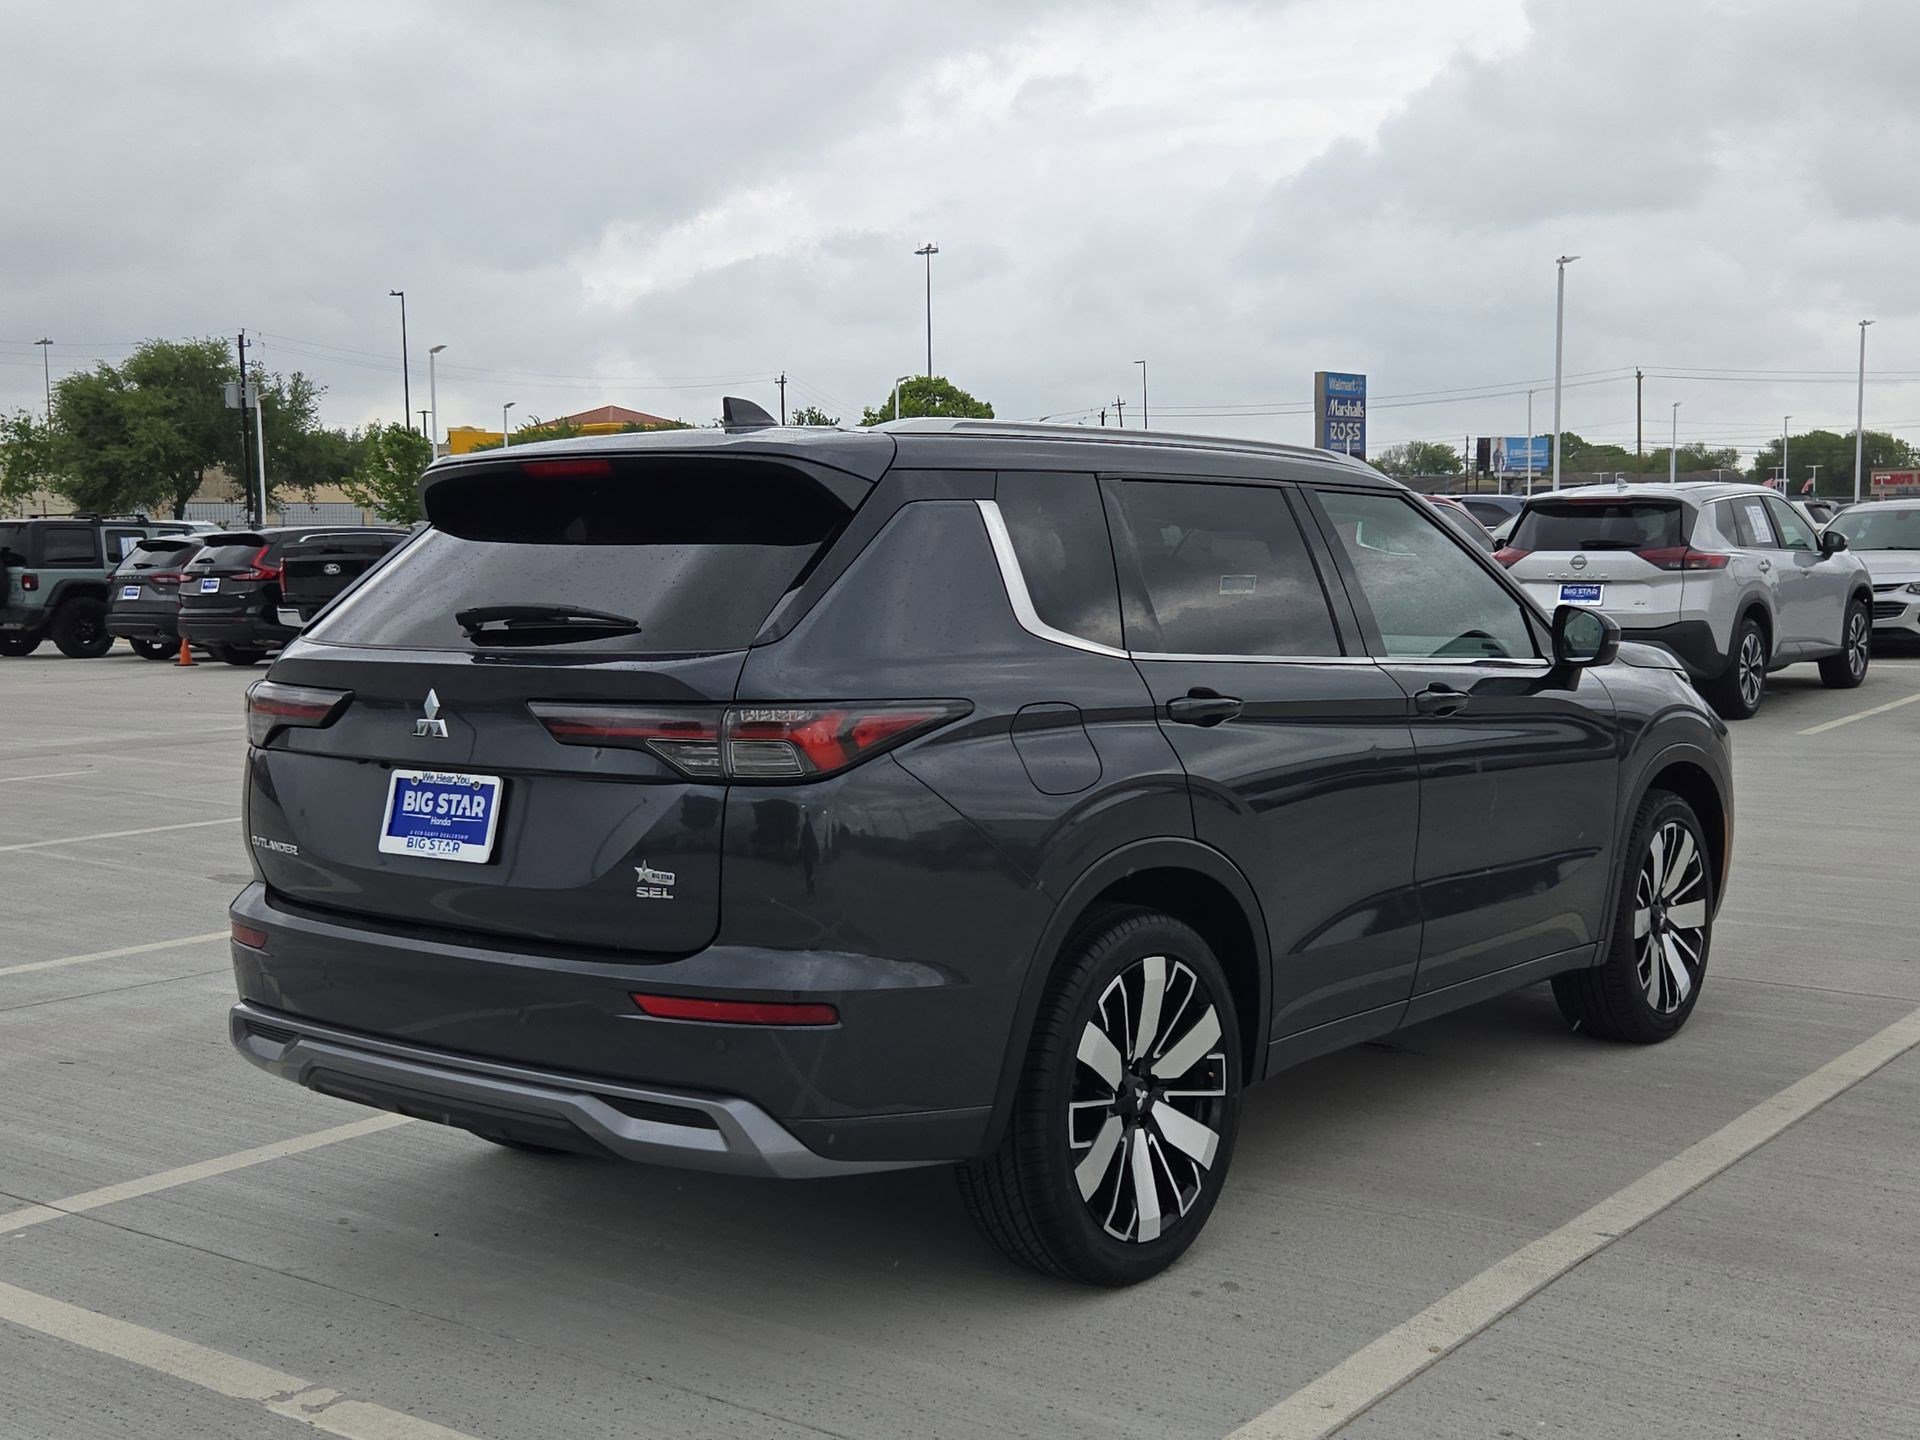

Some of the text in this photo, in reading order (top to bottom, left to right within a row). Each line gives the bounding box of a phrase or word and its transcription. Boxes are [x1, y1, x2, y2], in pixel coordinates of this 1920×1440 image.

[1329, 377, 1356, 391] Walmart
[1328, 399, 1364, 417] Marshalls
[1330, 422, 1360, 440] ROSS
[422, 772, 471, 784] We Hear You
[402, 790, 484, 817] BIG STAR
[430, 816, 452, 826] Honda
[251, 835, 299, 856] OUTLANDER
[406, 837, 461, 853] BIG STAR
[636, 886, 674, 899] SEL
